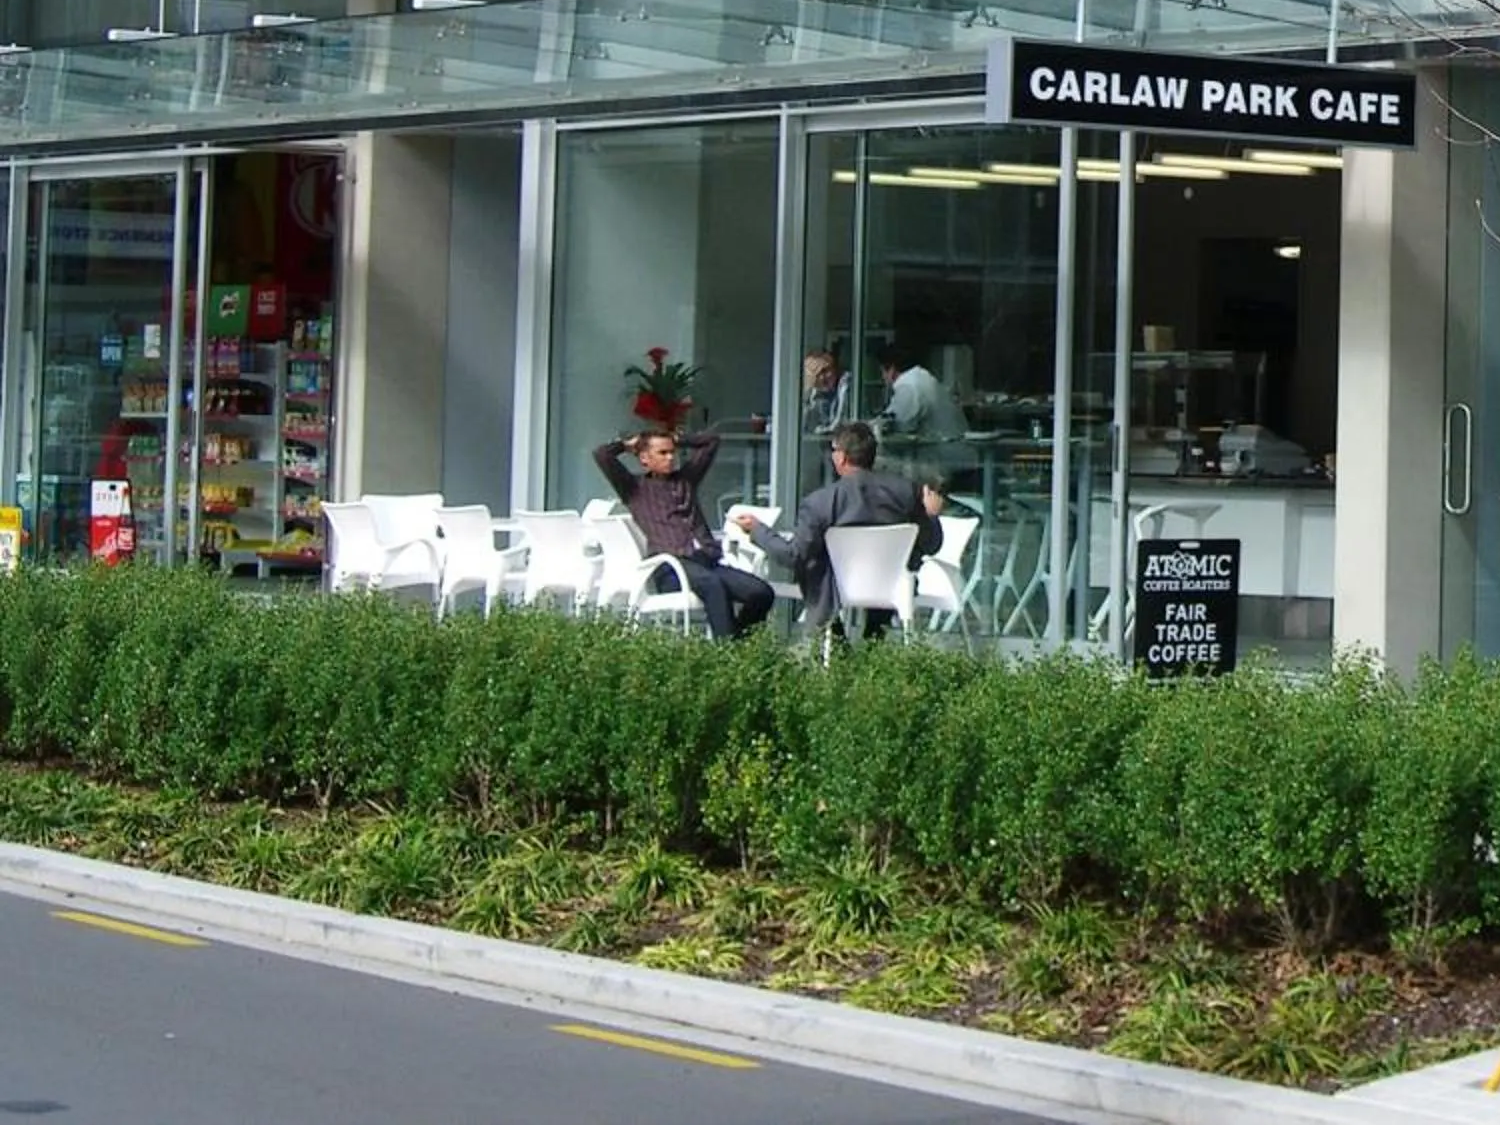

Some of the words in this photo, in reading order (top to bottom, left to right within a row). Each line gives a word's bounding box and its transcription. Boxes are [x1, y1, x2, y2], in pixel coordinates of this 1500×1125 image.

[1029, 66, 1190, 110] CARLAW
[1202, 80, 1299, 118] PARK
[1309, 88, 1401, 125] CAFE
[1144, 550, 1232, 580] ATOMIC
[1143, 580, 1180, 592] COFFEE
[1182, 579, 1231, 591] ROASTERS
[1165, 603, 1207, 622] FAIR
[1155, 623, 1217, 643] TRADE
[1147, 643, 1223, 663] COFFEE
